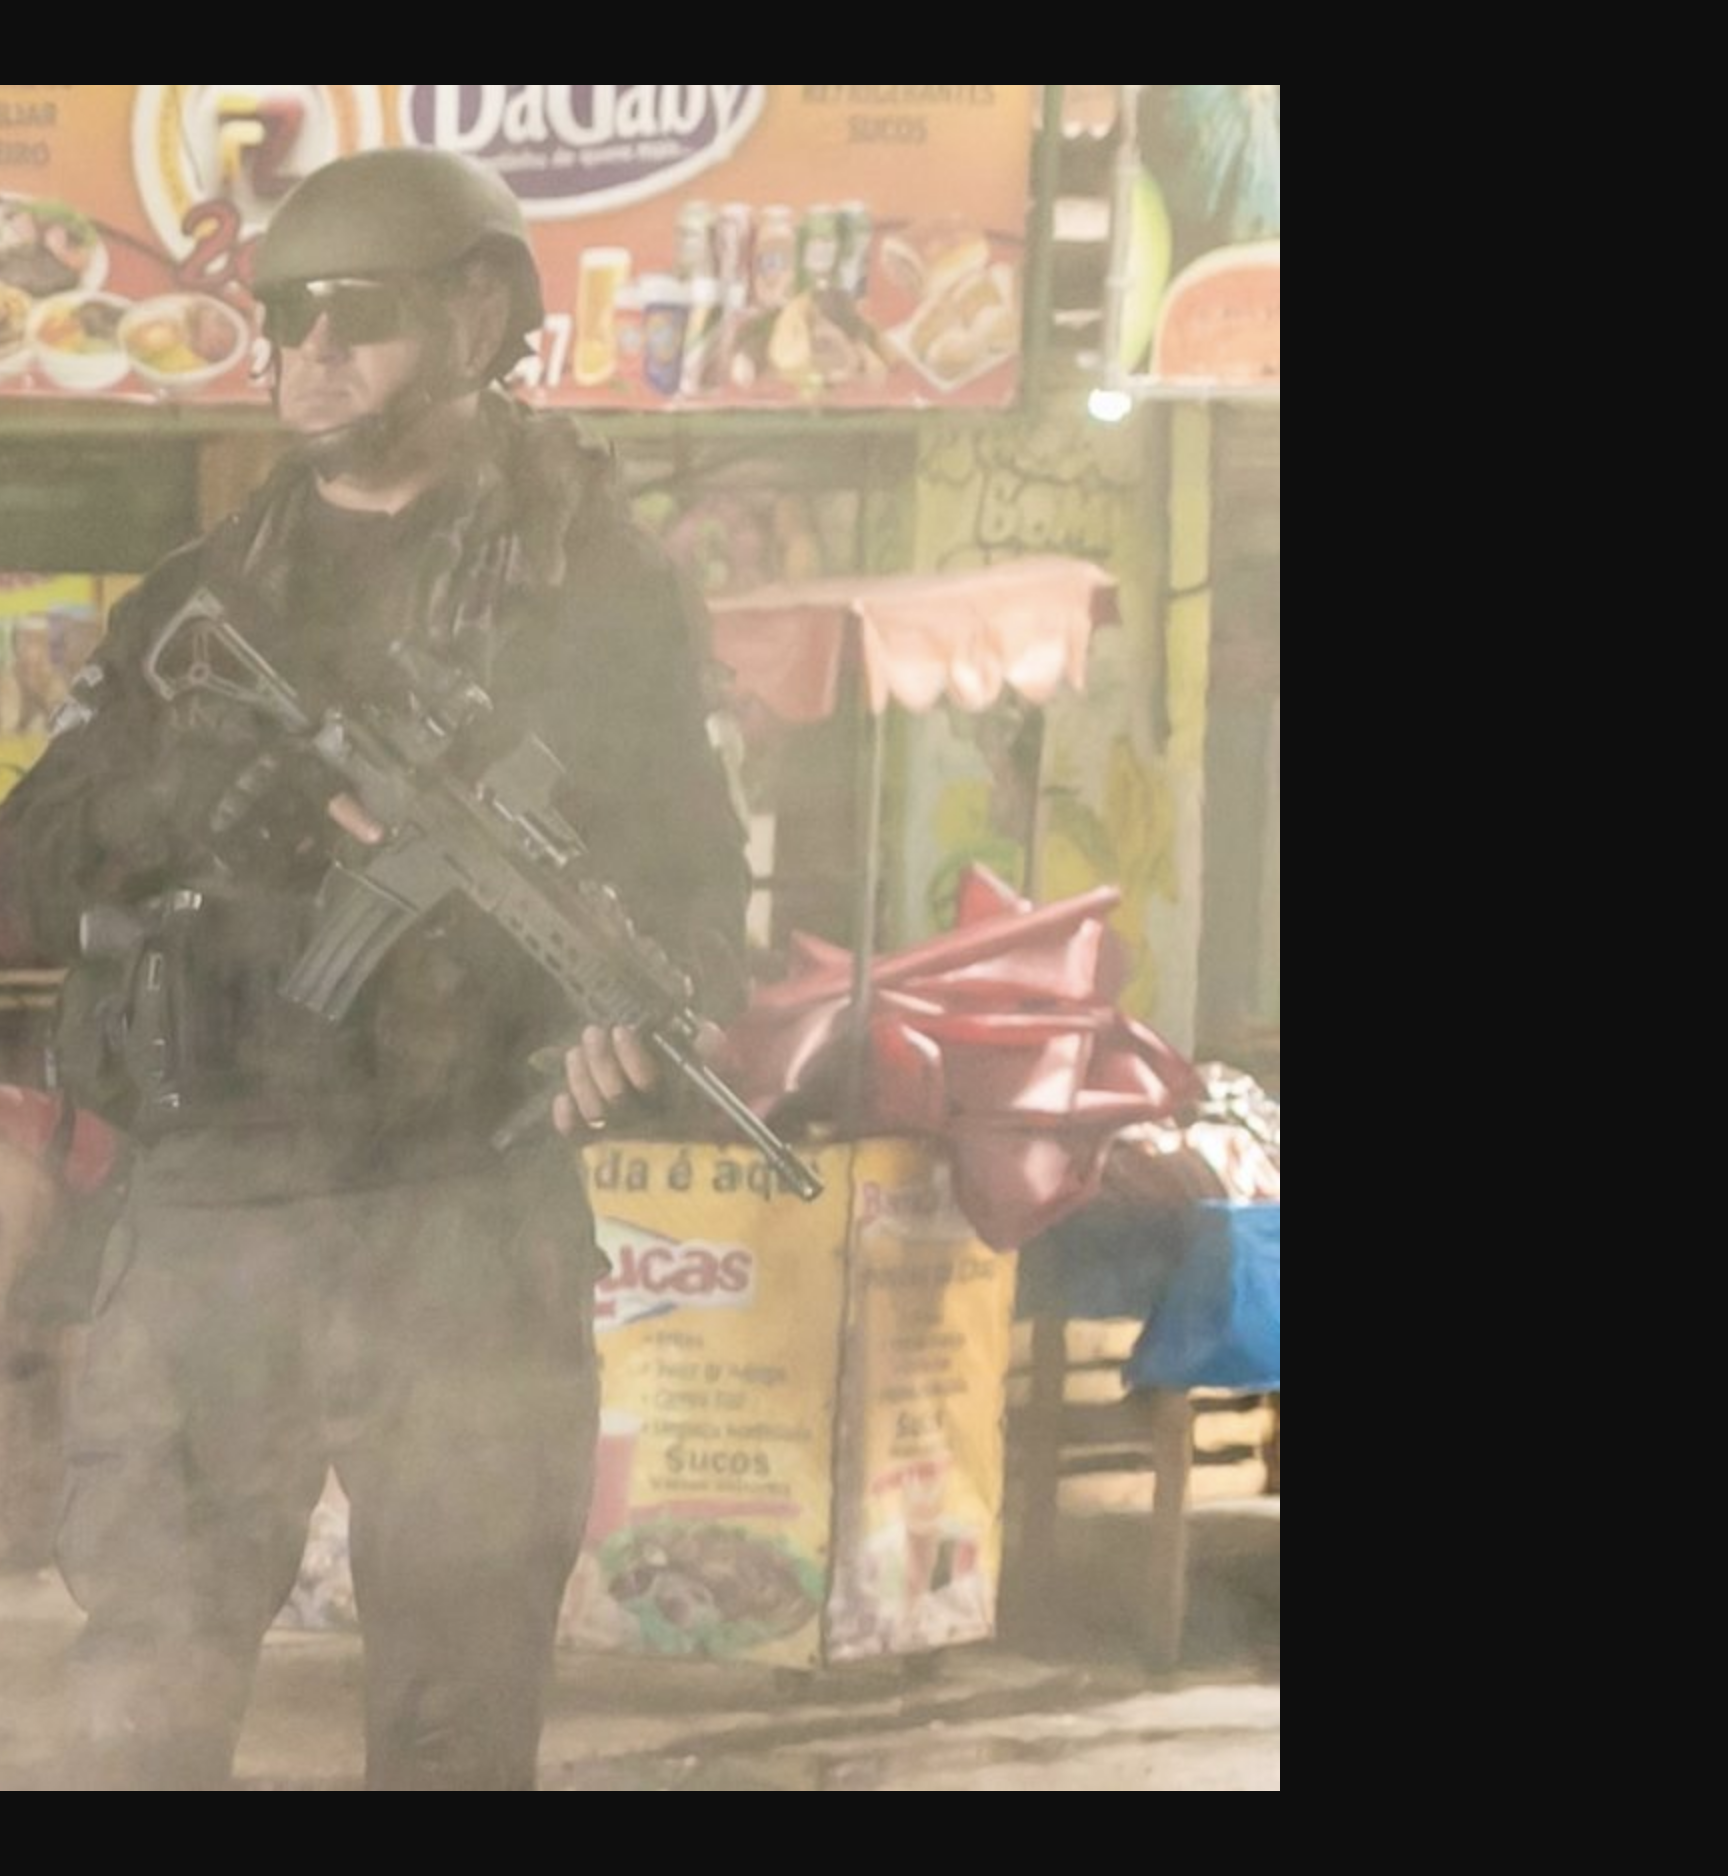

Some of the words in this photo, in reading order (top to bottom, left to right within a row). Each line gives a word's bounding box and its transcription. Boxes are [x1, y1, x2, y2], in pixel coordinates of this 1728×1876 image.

[847, 114, 927, 143] SUCOS
[595, 1150, 648, 1192] da
[594, 1245, 753, 1296] ucas
[664, 1443, 770, 1476] Sucos
